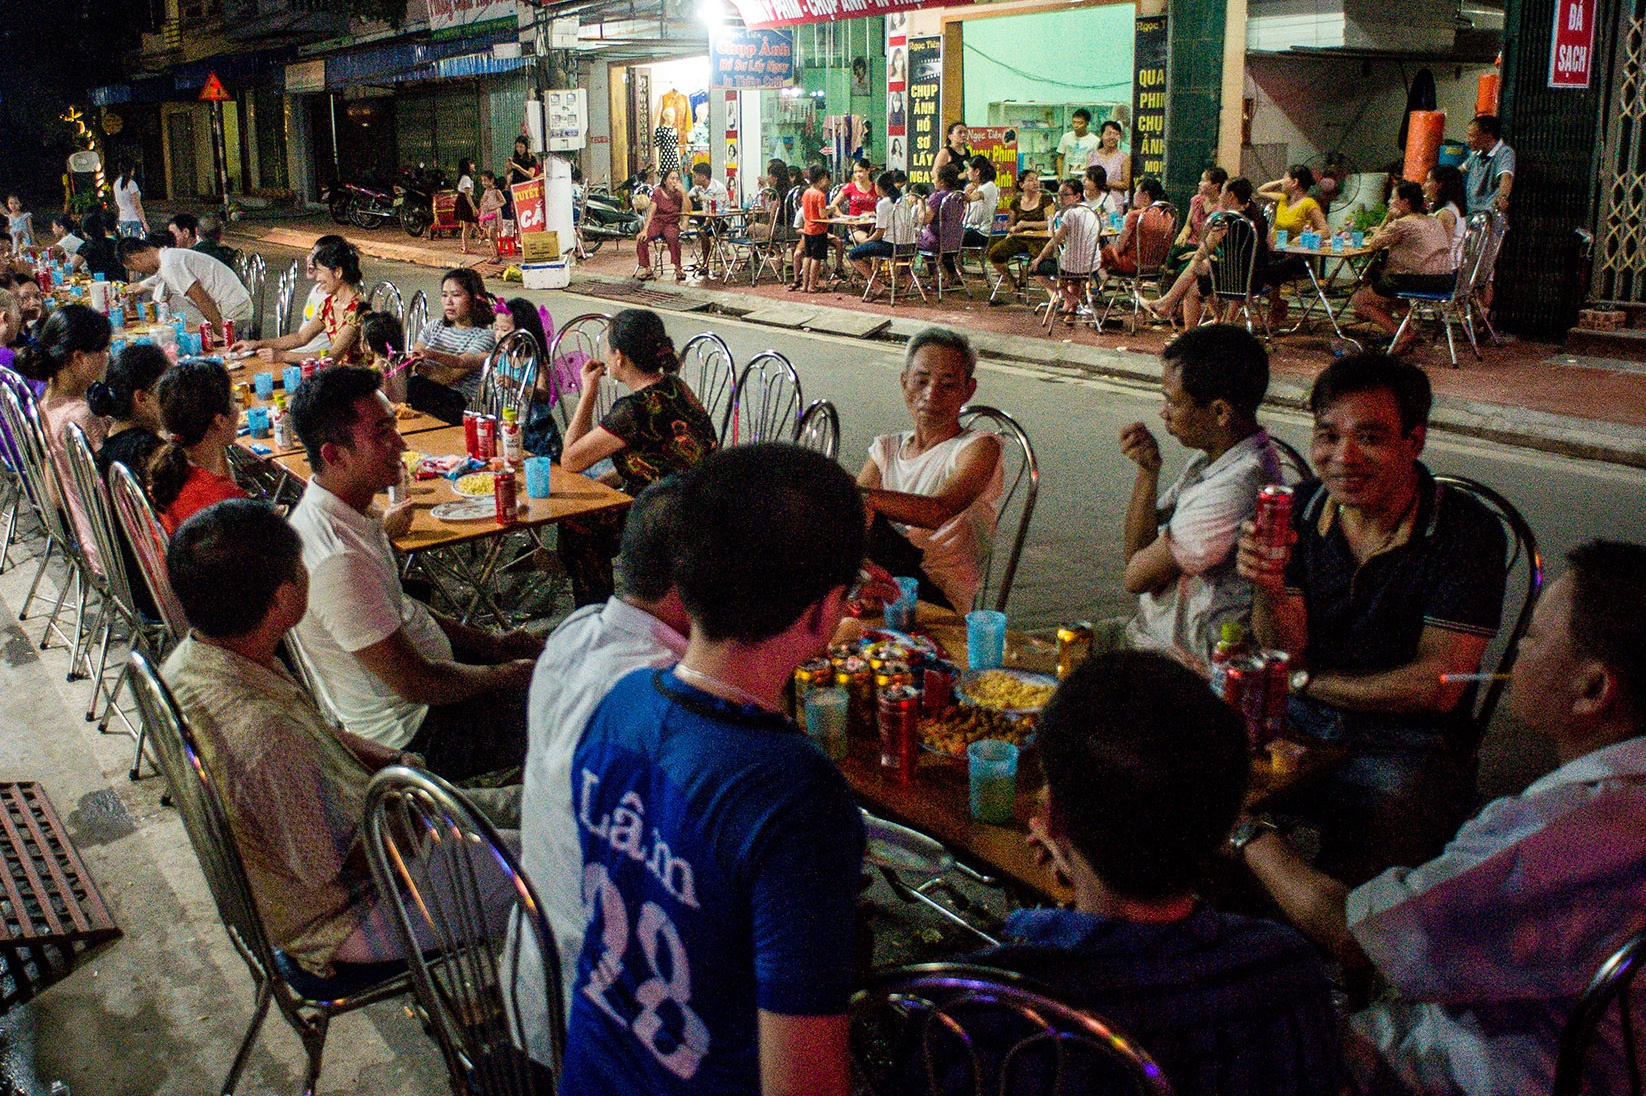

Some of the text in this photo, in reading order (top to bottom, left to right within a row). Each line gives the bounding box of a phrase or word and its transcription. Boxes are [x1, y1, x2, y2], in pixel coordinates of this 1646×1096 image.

[716, 36, 791, 58] Chụp Ảnh
[734, 60, 747, 71] Sơ
[748, 59, 765, 73] Lấy
[1558, 44, 1587, 78] SẠCH
[910, 83, 939, 100] CHỤP
[913, 98, 935, 115] ẢNH
[1137, 115, 1164, 135] CHỤ
[916, 134, 931, 149] SƠ
[913, 150, 934, 167] LẤY
[992, 144, 1017, 162] Phim
[994, 164, 1013, 188] Ảnh
[514, 184, 539, 203] TUYẾT
